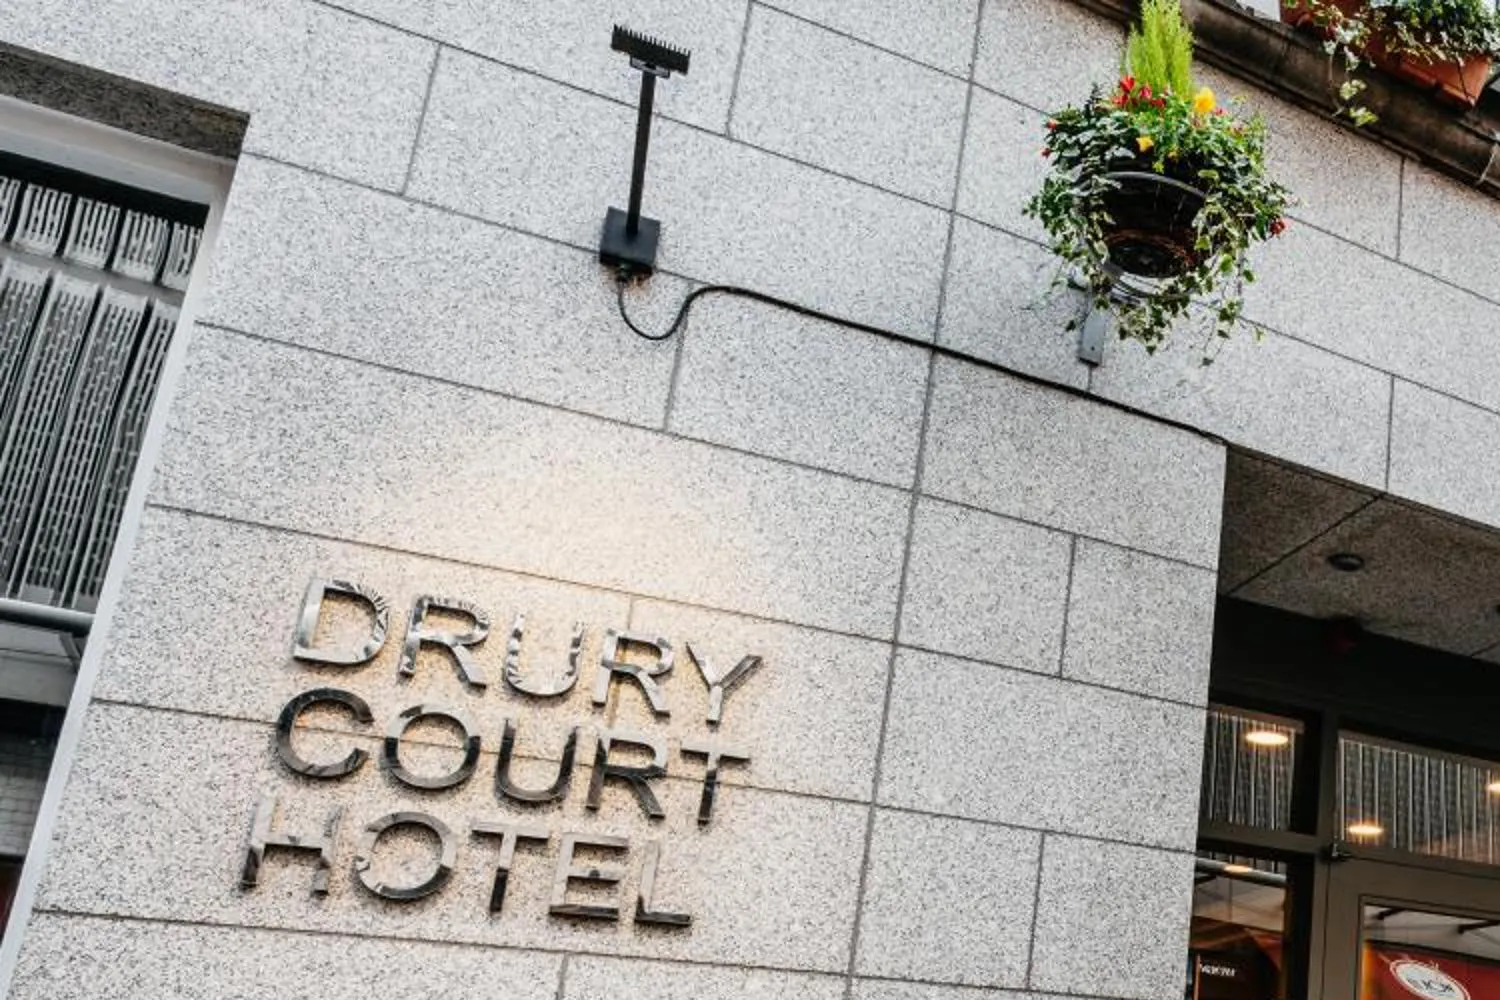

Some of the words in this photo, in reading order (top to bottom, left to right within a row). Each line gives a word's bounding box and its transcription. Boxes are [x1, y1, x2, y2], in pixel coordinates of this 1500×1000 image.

[291, 577, 763, 726] DRURY
[275, 687, 752, 826] COURT
[239, 800, 693, 928] HOTEL
